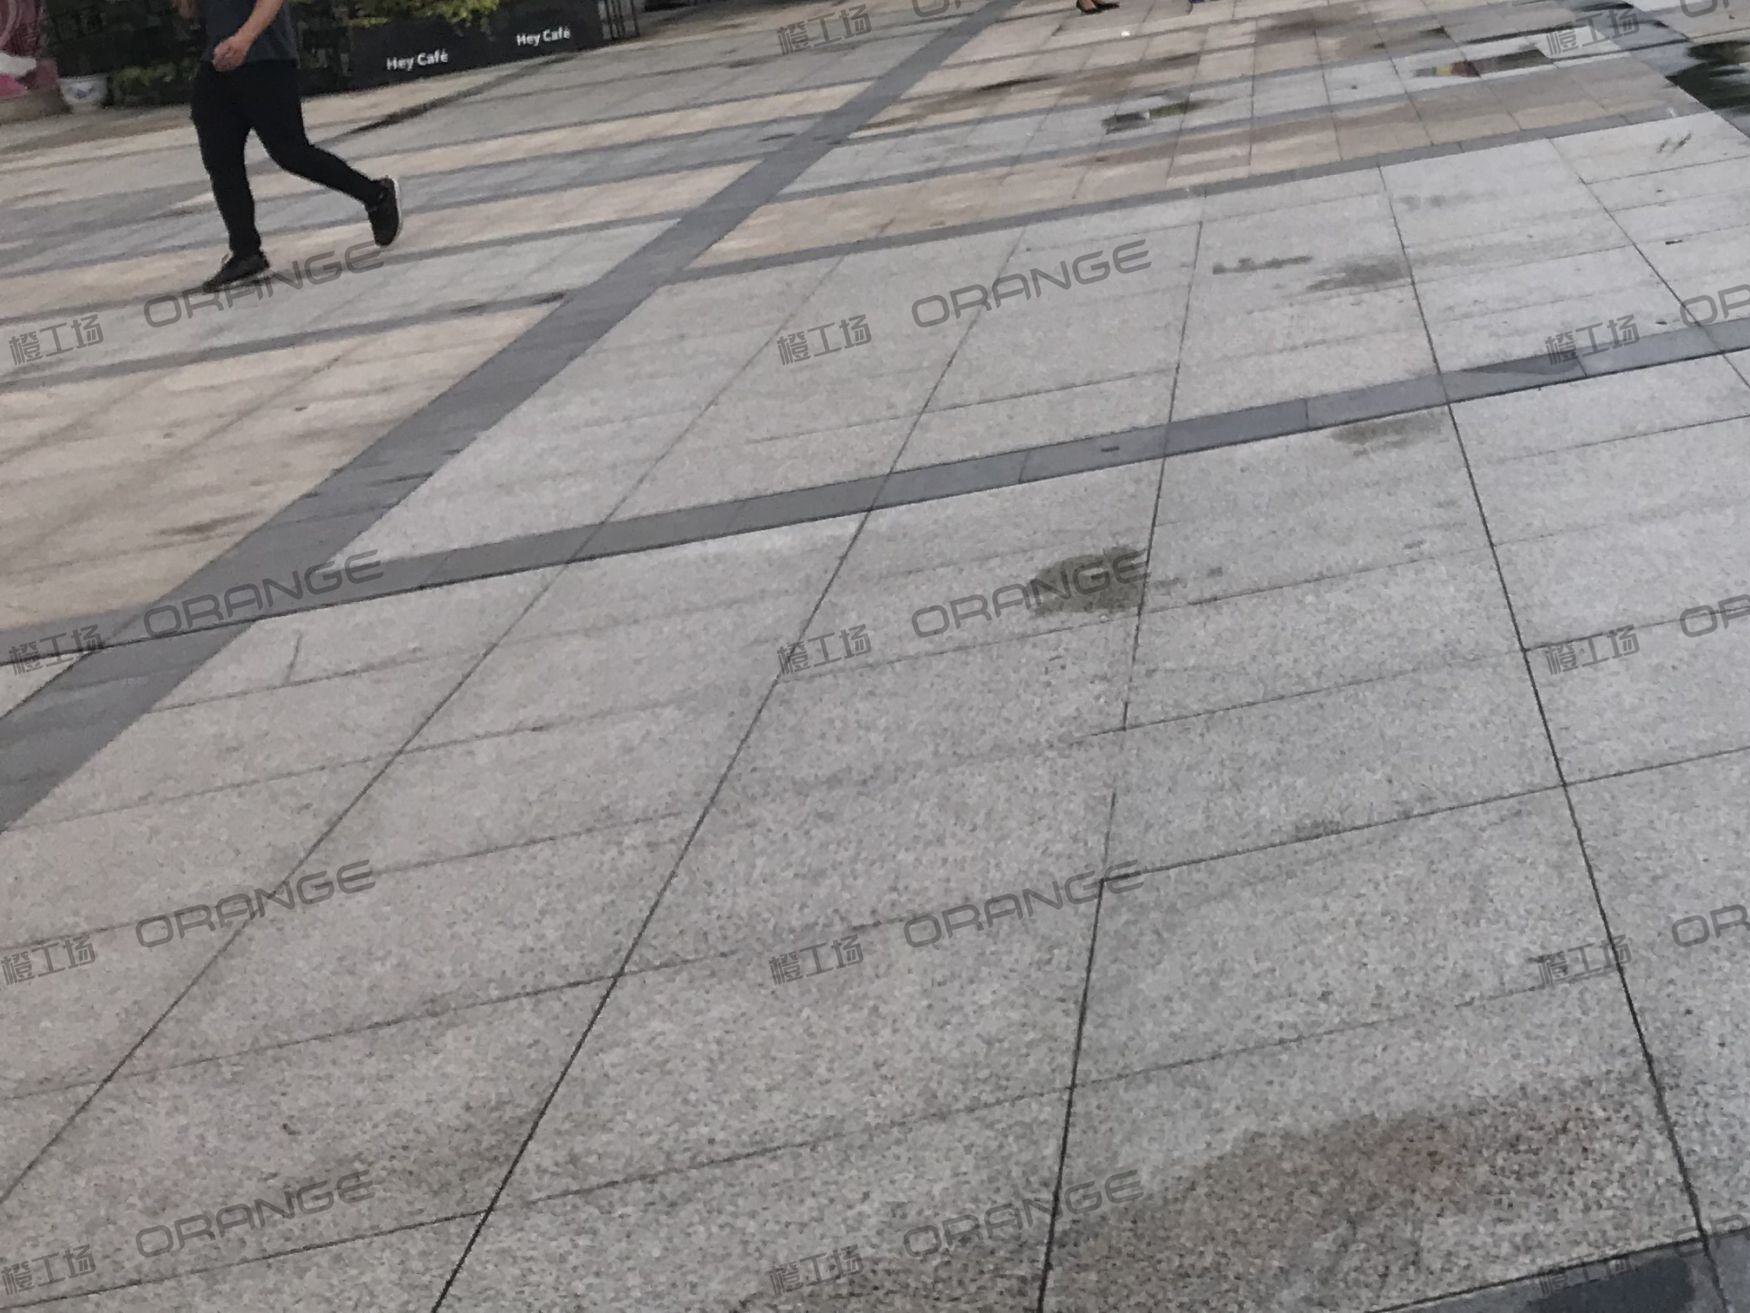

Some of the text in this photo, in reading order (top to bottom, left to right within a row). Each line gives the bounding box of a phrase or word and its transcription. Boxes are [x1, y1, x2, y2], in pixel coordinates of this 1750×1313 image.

[516, 26, 571, 47] Hey Café
[386, 49, 448, 71] Hey Café
